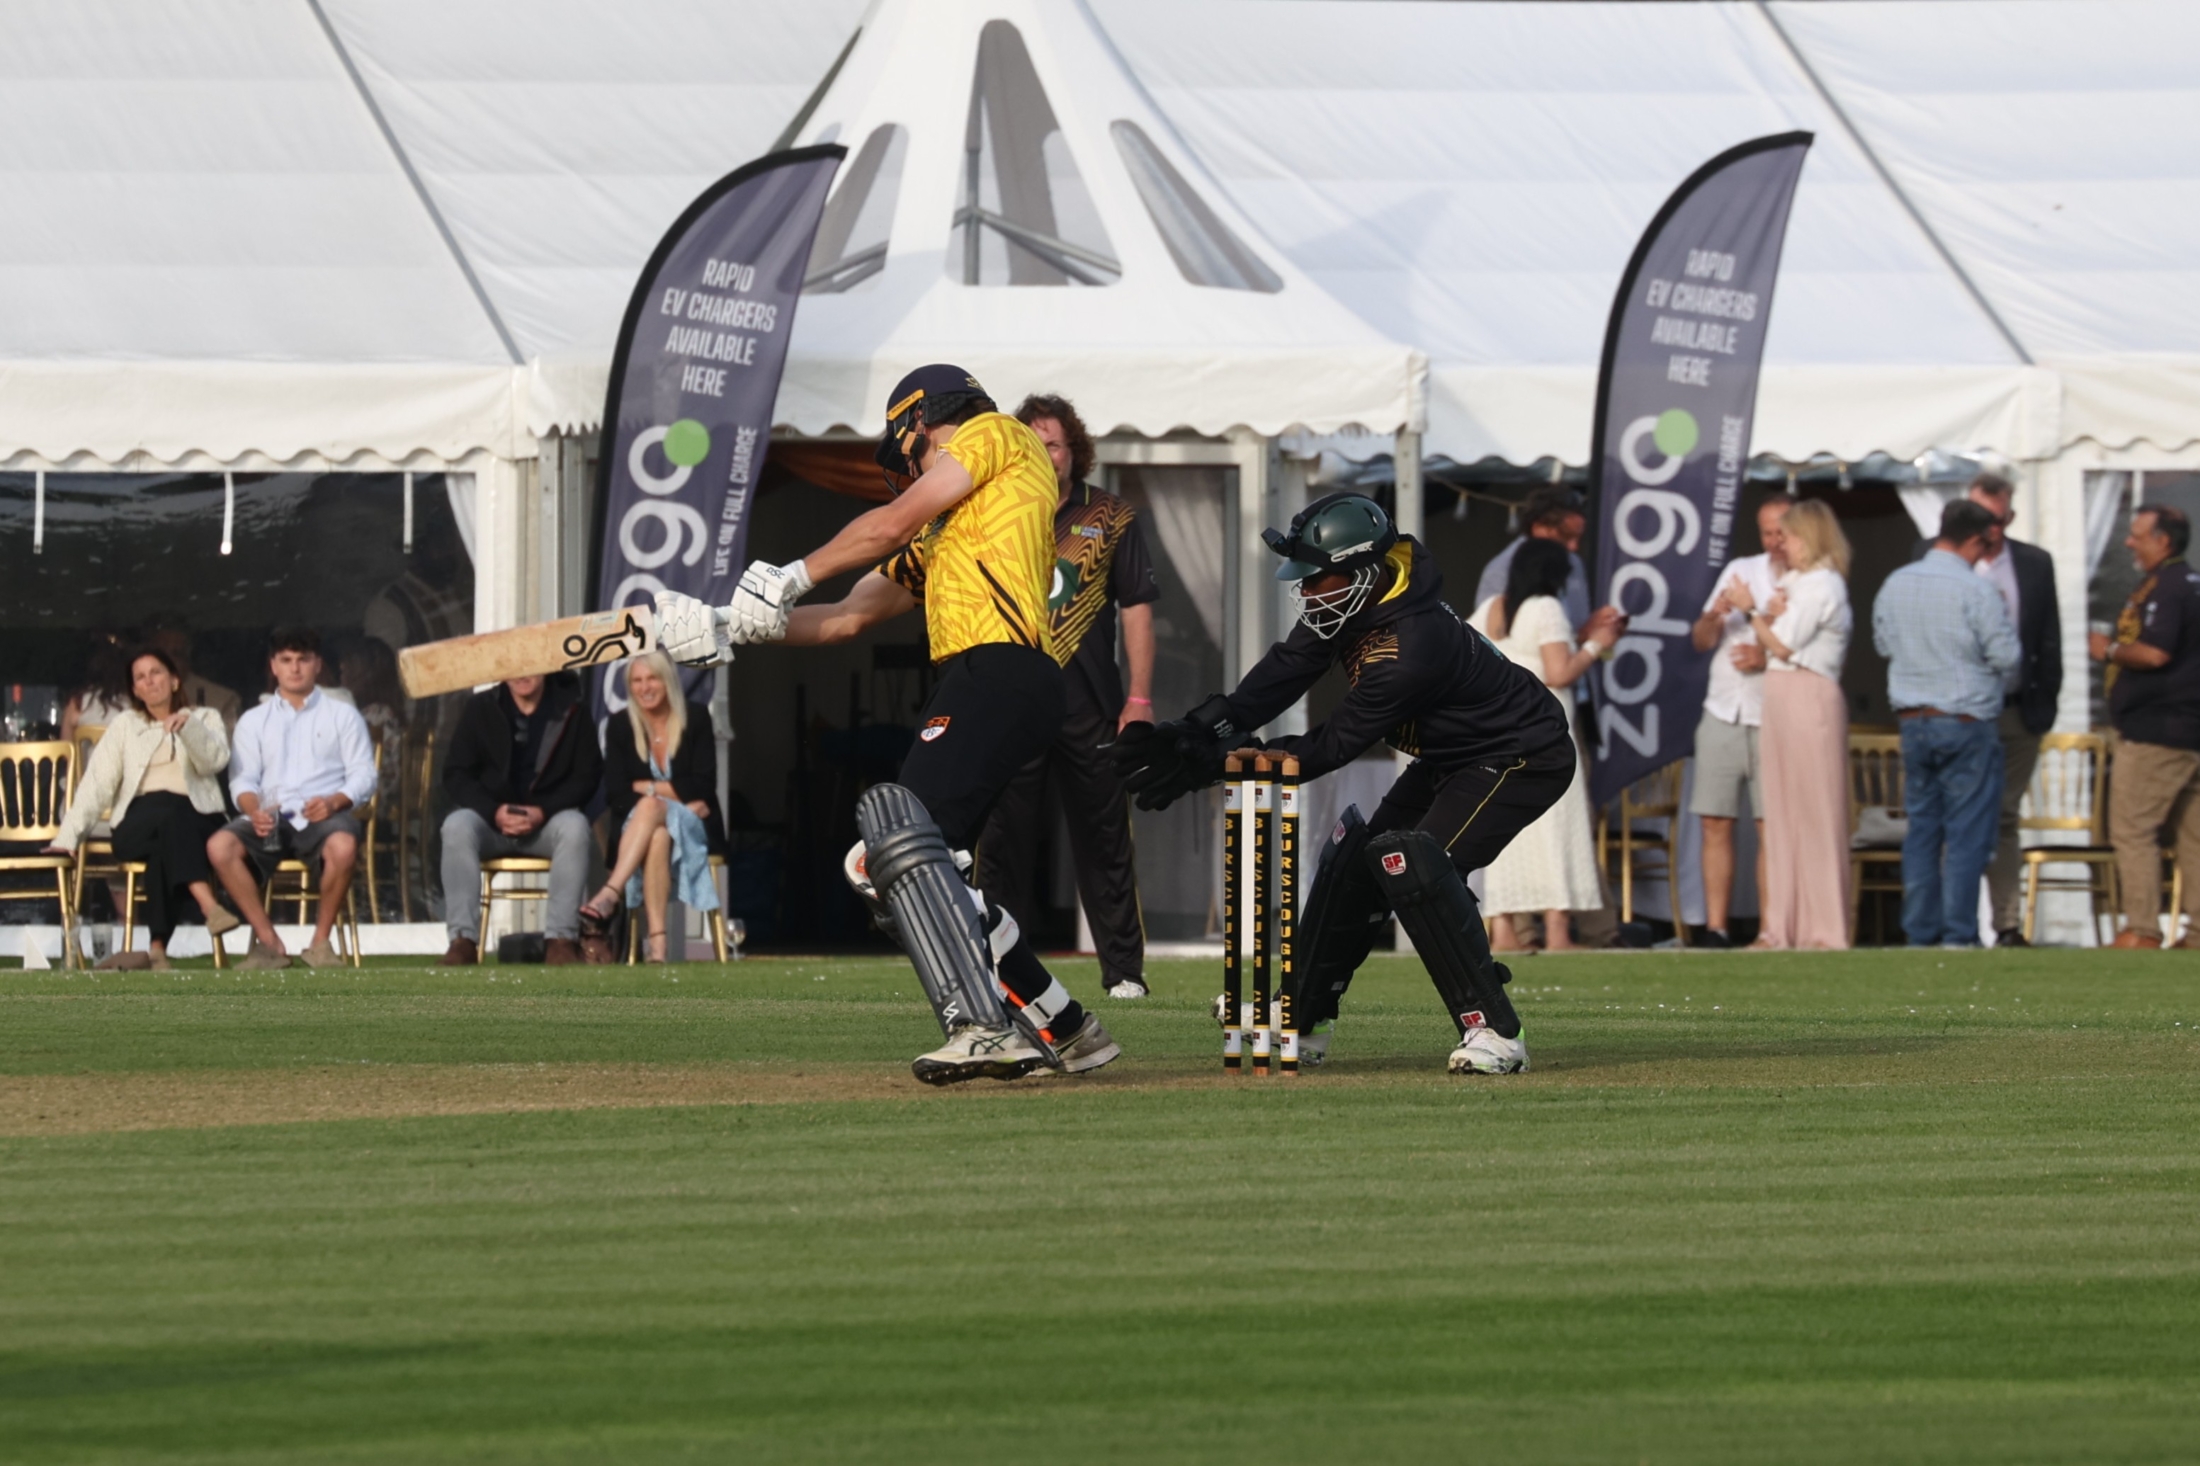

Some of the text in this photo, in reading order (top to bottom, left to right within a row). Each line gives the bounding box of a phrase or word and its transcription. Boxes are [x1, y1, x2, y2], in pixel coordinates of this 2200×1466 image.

[702, 258, 755, 292] RAPID
[1684, 248, 1736, 281] RAPID
[660, 287, 777, 333] EV CHARGERS
[1646, 278, 1758, 322] EV CHARGERS
[664, 325, 757, 366] AVAILABLE
[1650, 315, 1739, 355] AVAILABLE
[681, 365, 728, 397] HERE
[1667, 353, 1713, 387] HERE
[1717, 414, 1744, 473] CHARGE
[712, 425, 758, 576] LIFE ON FULL CHARGE
[1713, 477, 1738, 511] FULL
[1710, 511, 1733, 535] ON
[1280, 822, 1292, 1025] BURSCOUGH CC
